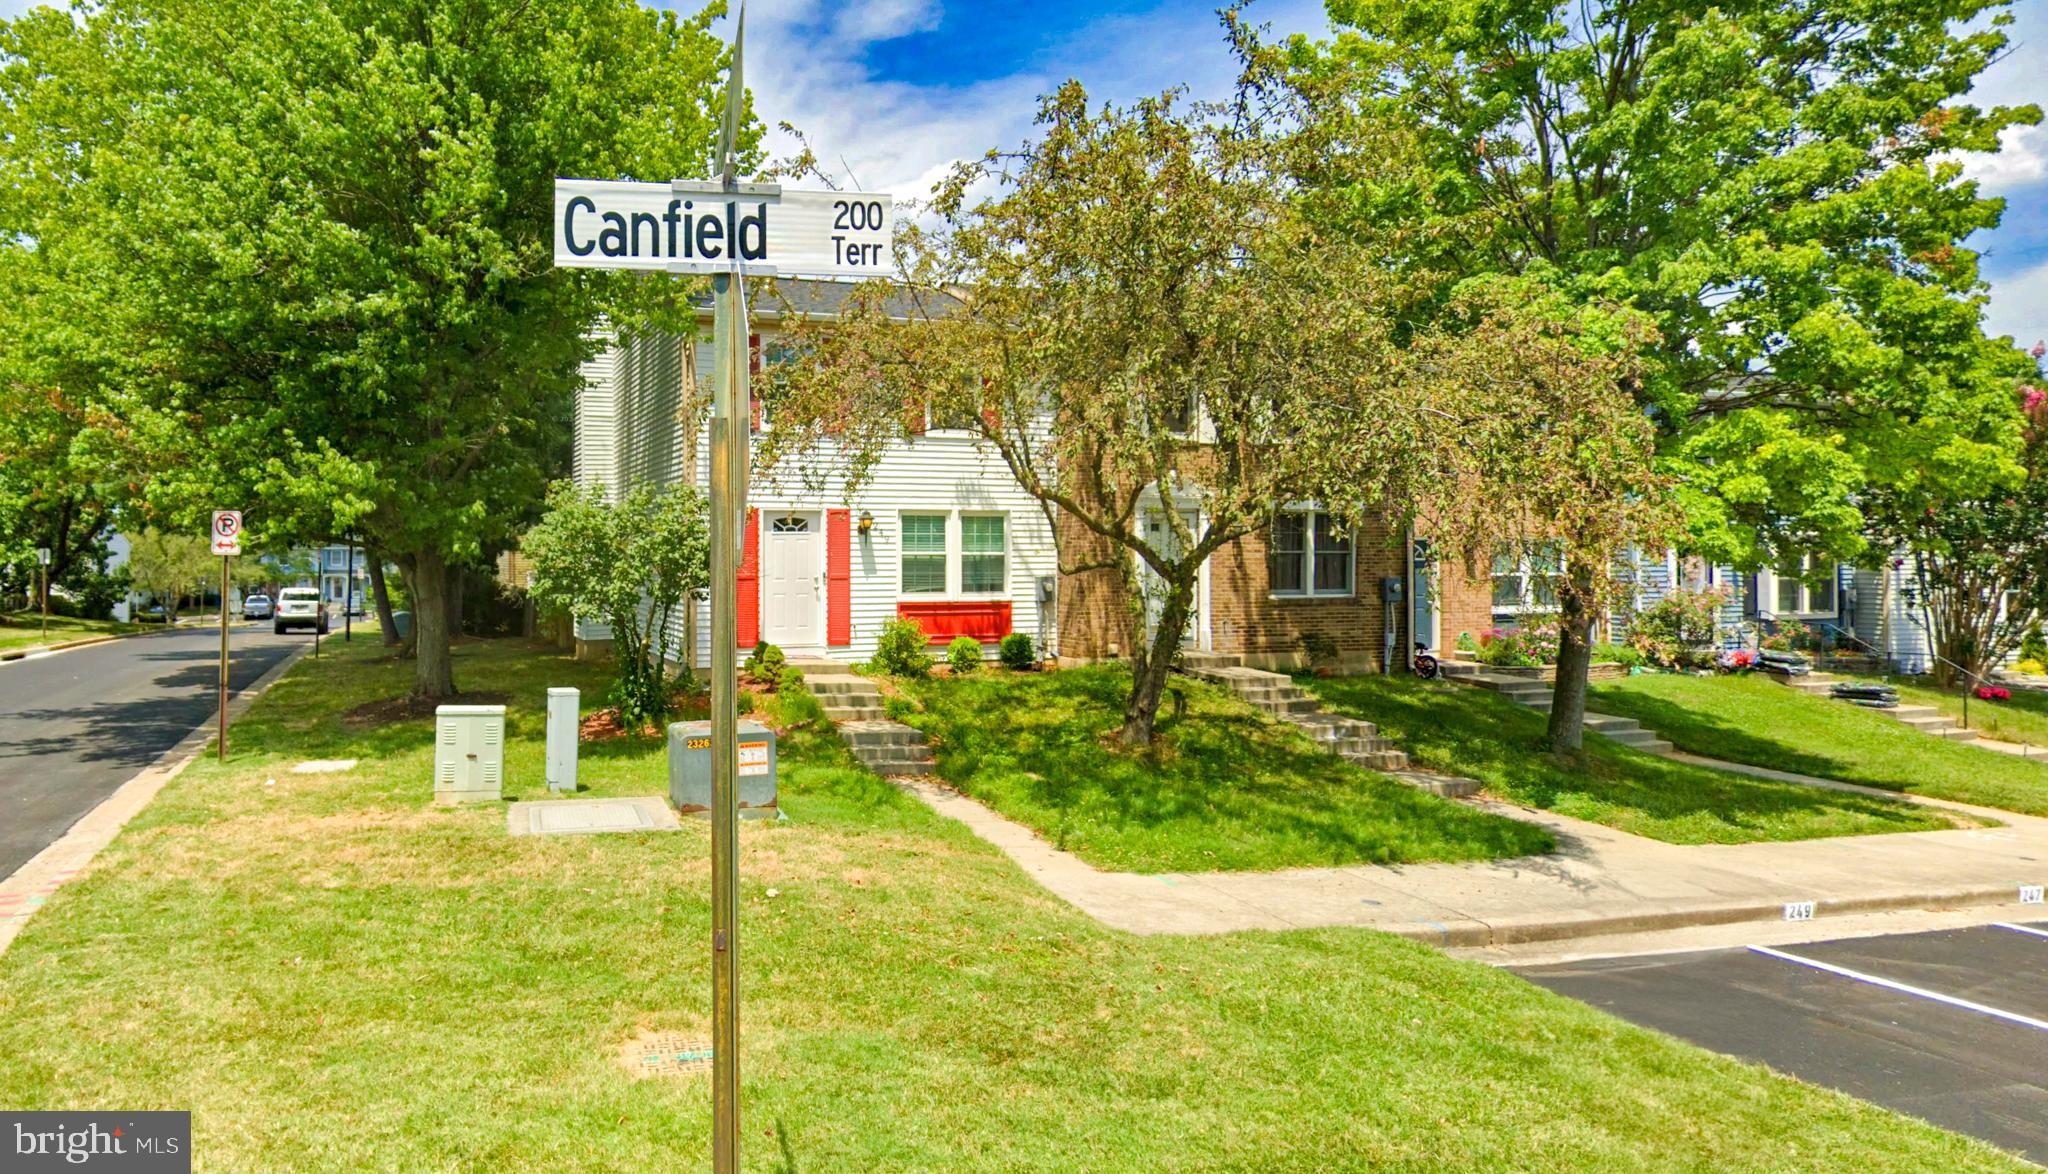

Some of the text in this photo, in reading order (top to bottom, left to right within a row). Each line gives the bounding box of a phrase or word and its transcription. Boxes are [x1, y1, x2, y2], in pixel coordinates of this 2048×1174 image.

[564, 196, 767, 259] Canfield
[834, 201, 883, 230] 200
[831, 236, 883, 265] Terr
[687, 739, 711, 750] 2326
[1789, 904, 1811, 919] 249
